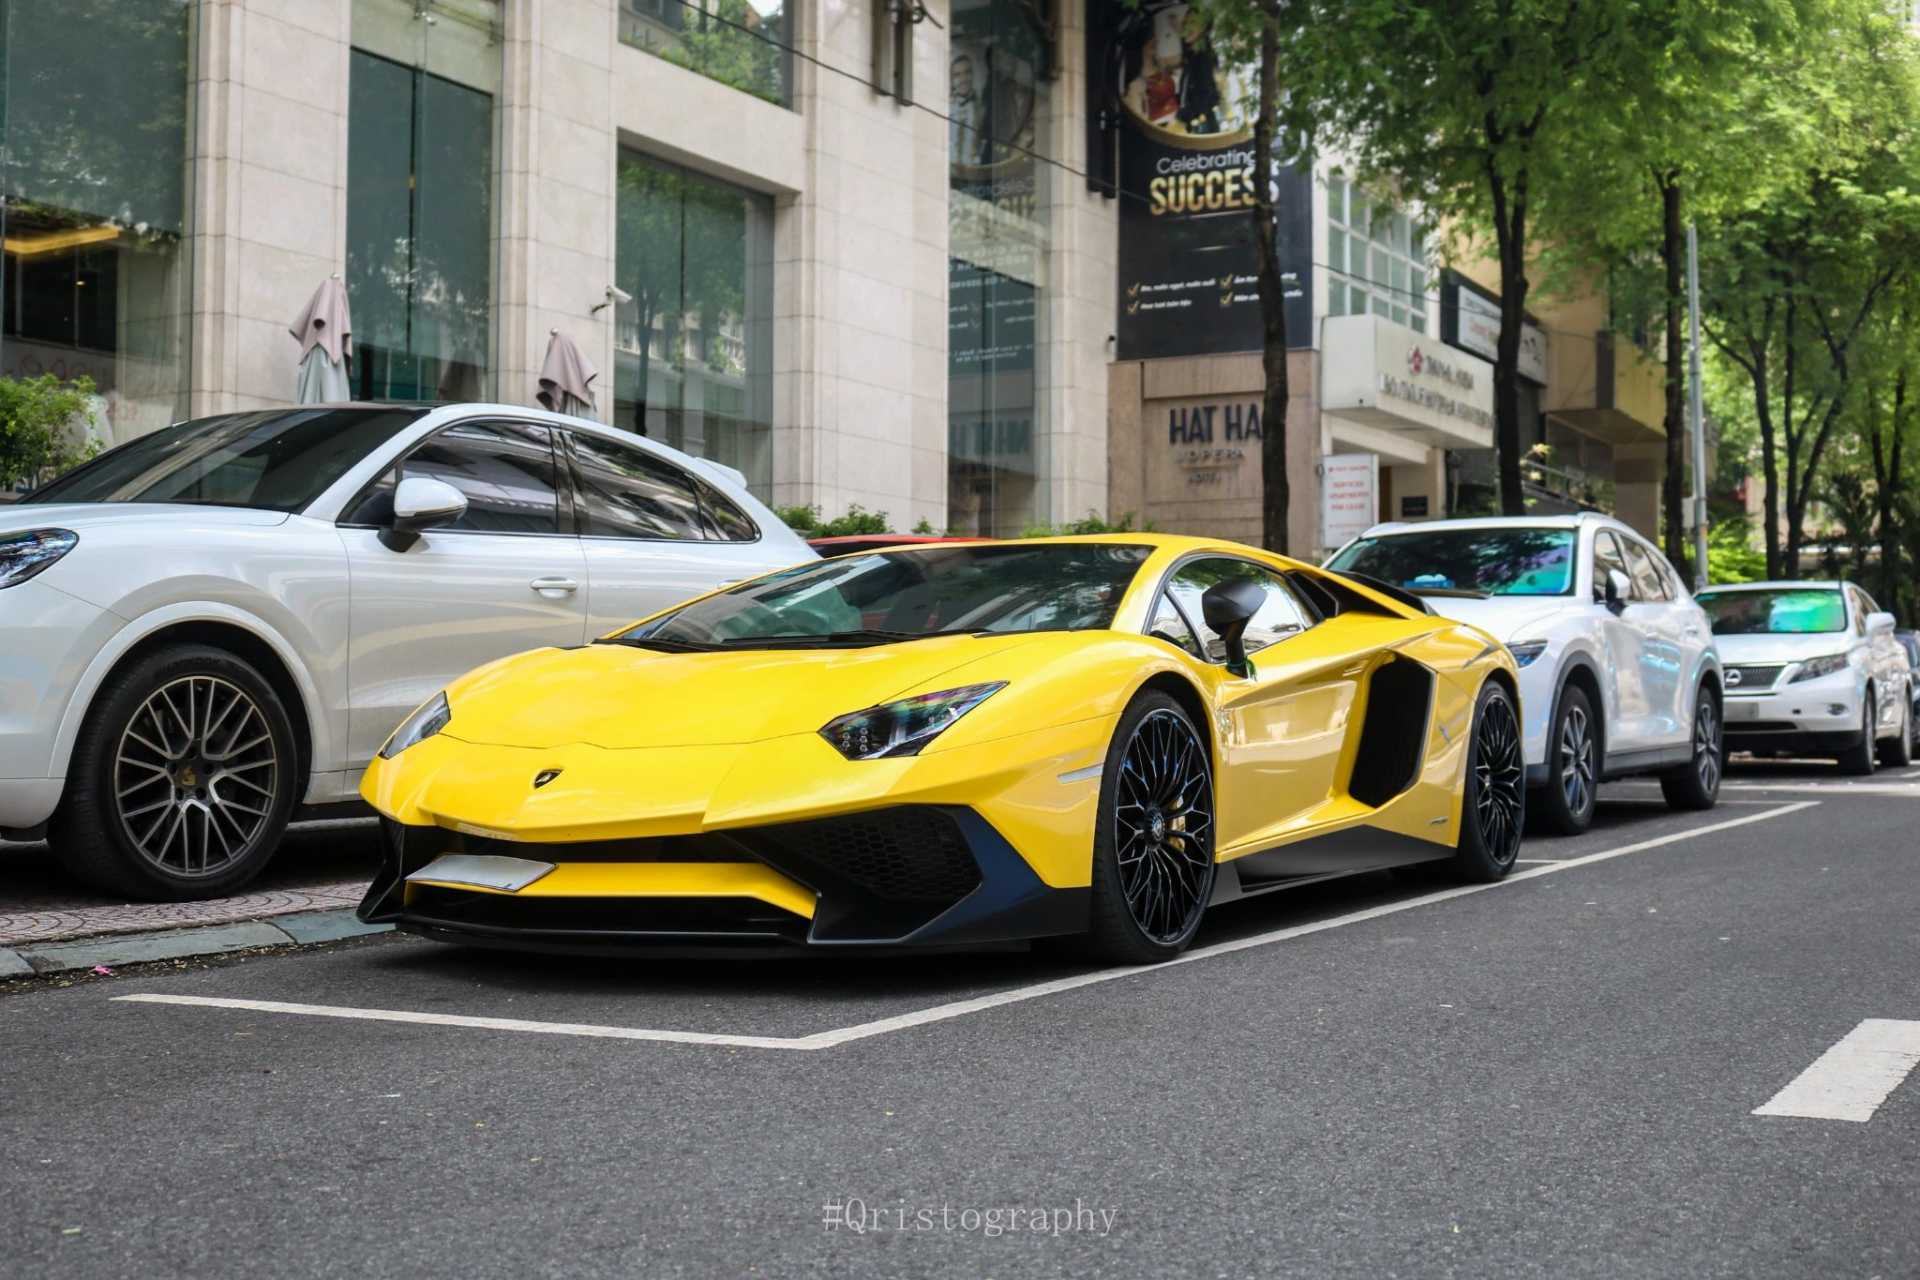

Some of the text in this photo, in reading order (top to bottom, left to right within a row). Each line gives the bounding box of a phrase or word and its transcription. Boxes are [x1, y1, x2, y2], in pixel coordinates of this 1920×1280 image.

[1156, 149, 1257, 175] Celebrating
[1169, 402, 1262, 445] HAT HA
